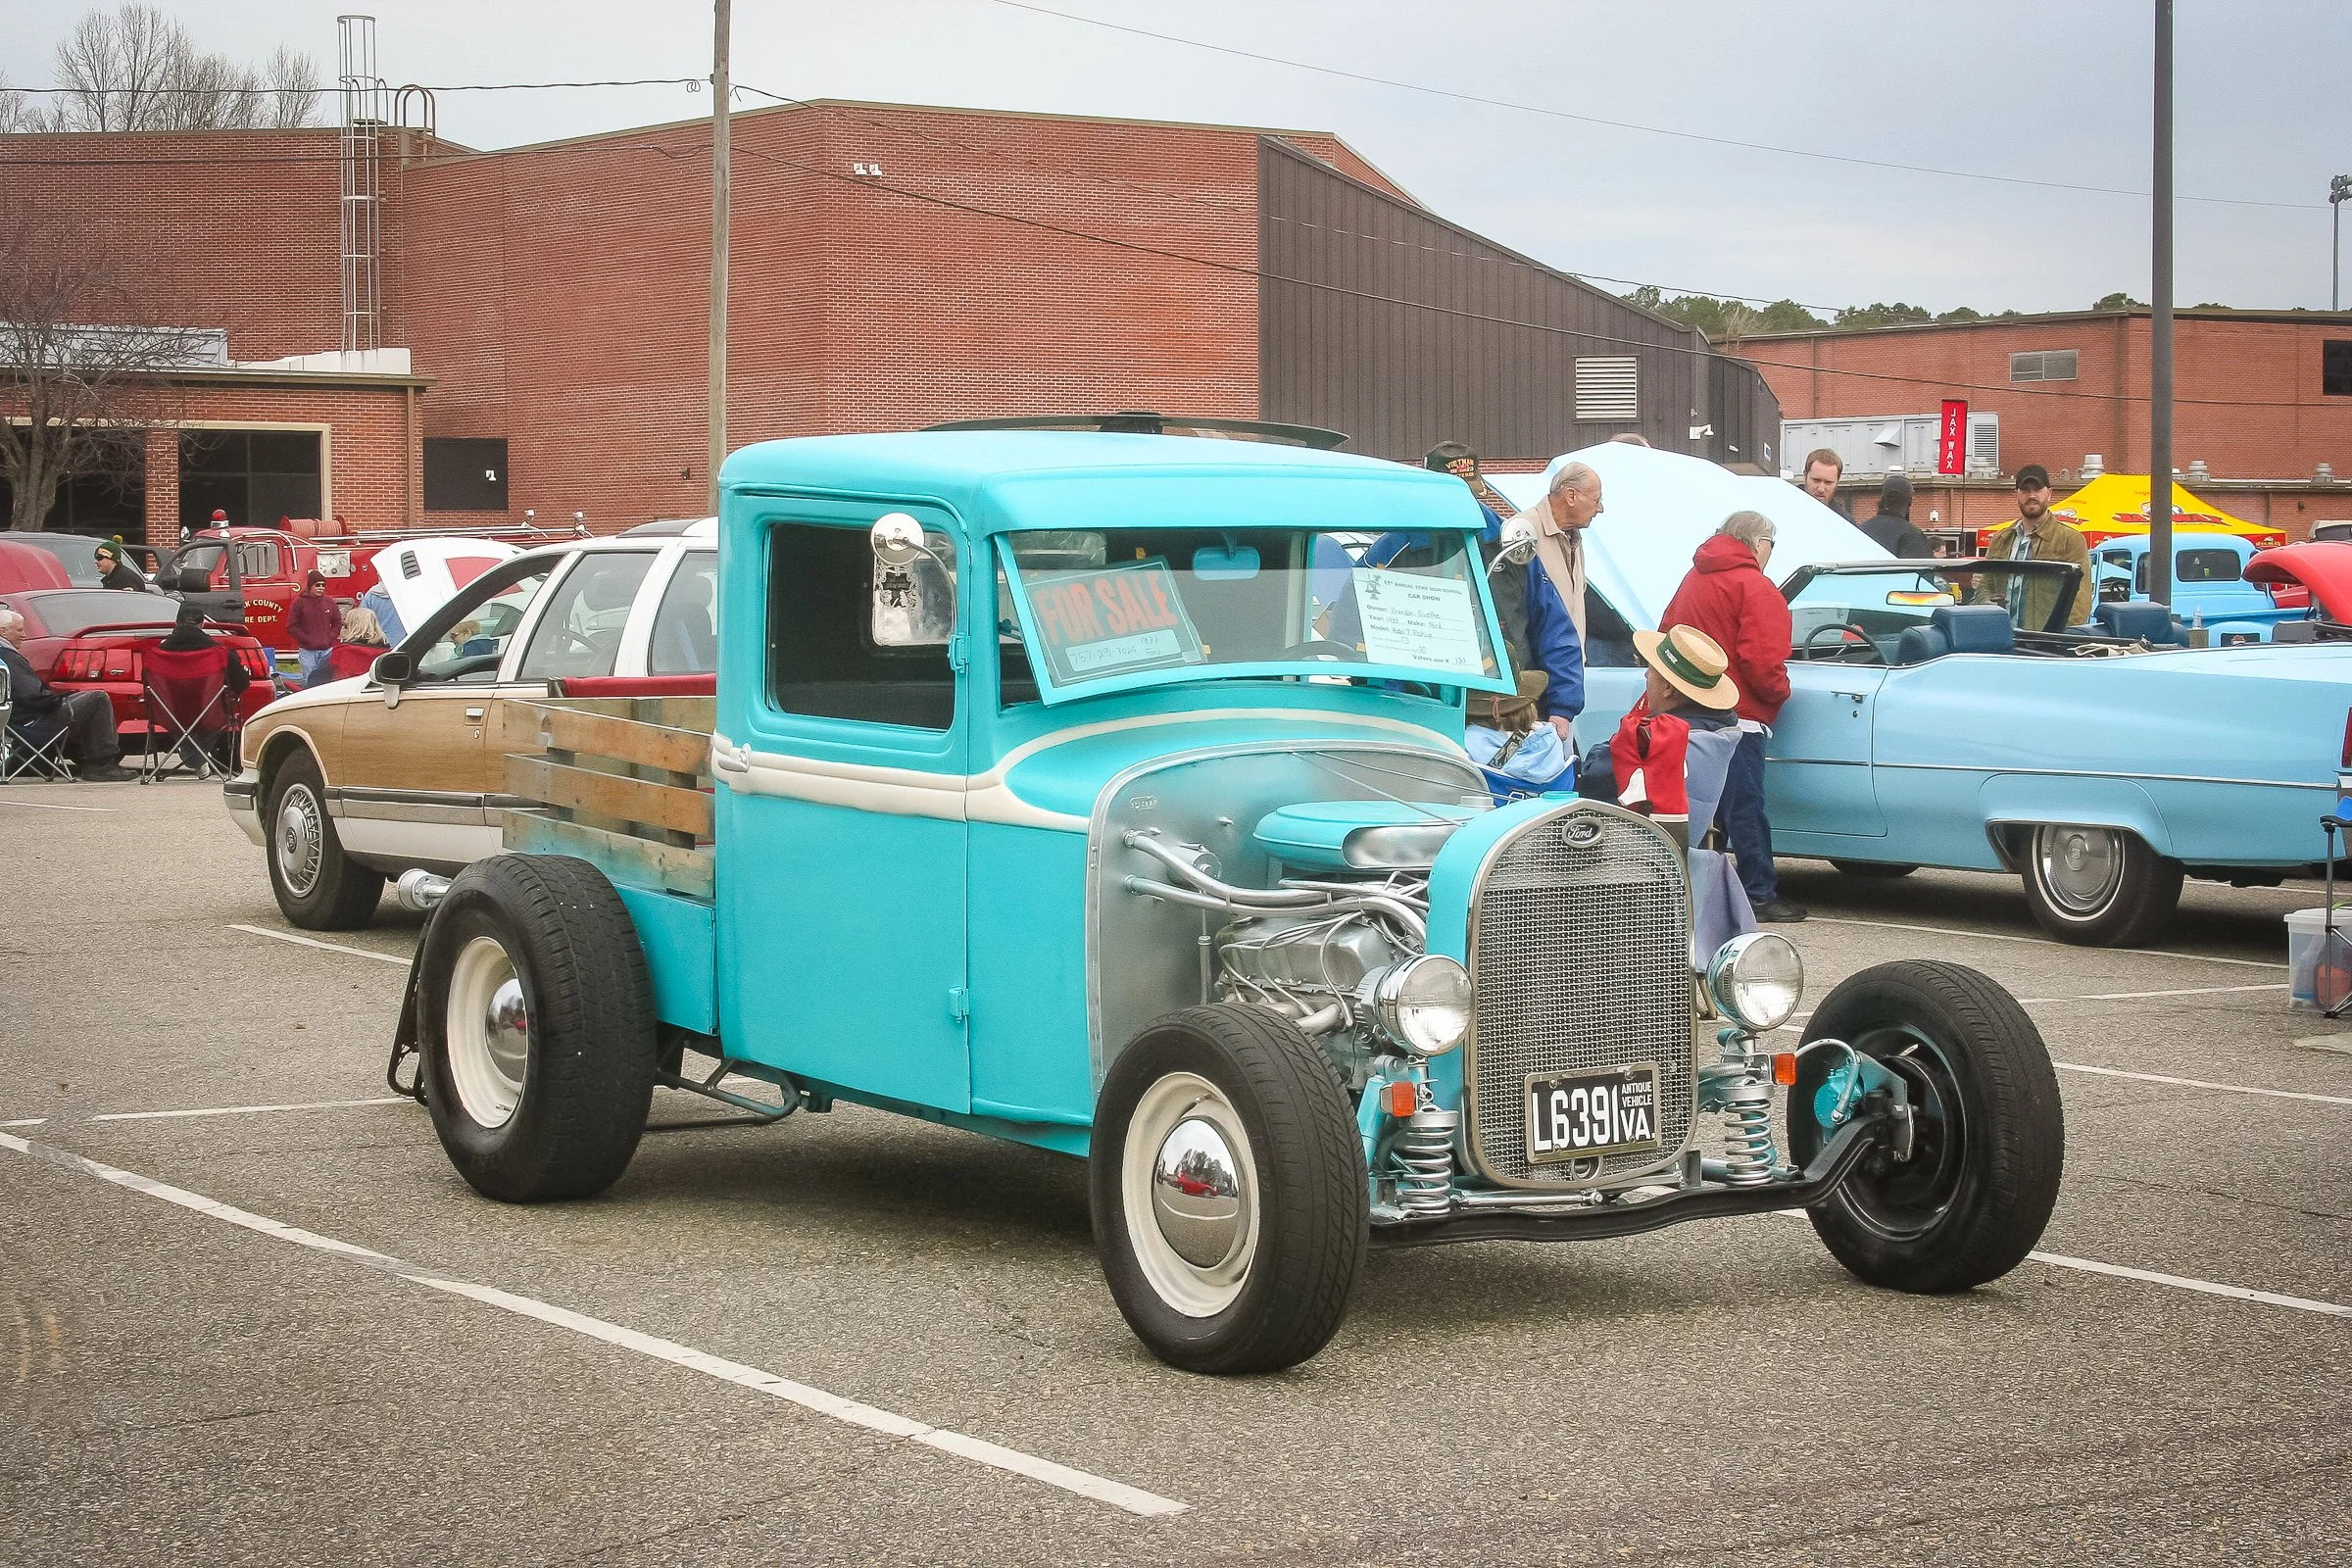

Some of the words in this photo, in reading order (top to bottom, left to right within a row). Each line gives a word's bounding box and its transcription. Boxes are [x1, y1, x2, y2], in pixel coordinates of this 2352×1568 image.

[1946, 441, 1955, 469] WAX
[253, 599, 283, 612] COUNTY
[1034, 583, 1104, 645] FOR
[1095, 570, 1178, 635] SALE
[257, 614, 278, 623] DEPT.
[1568, 824, 1593, 839] Ford
[1621, 1081, 1653, 1095] ANTIQUE
[1621, 1094, 1653, 1108] VEHICLE
[1532, 1084, 1620, 1152] L6391
